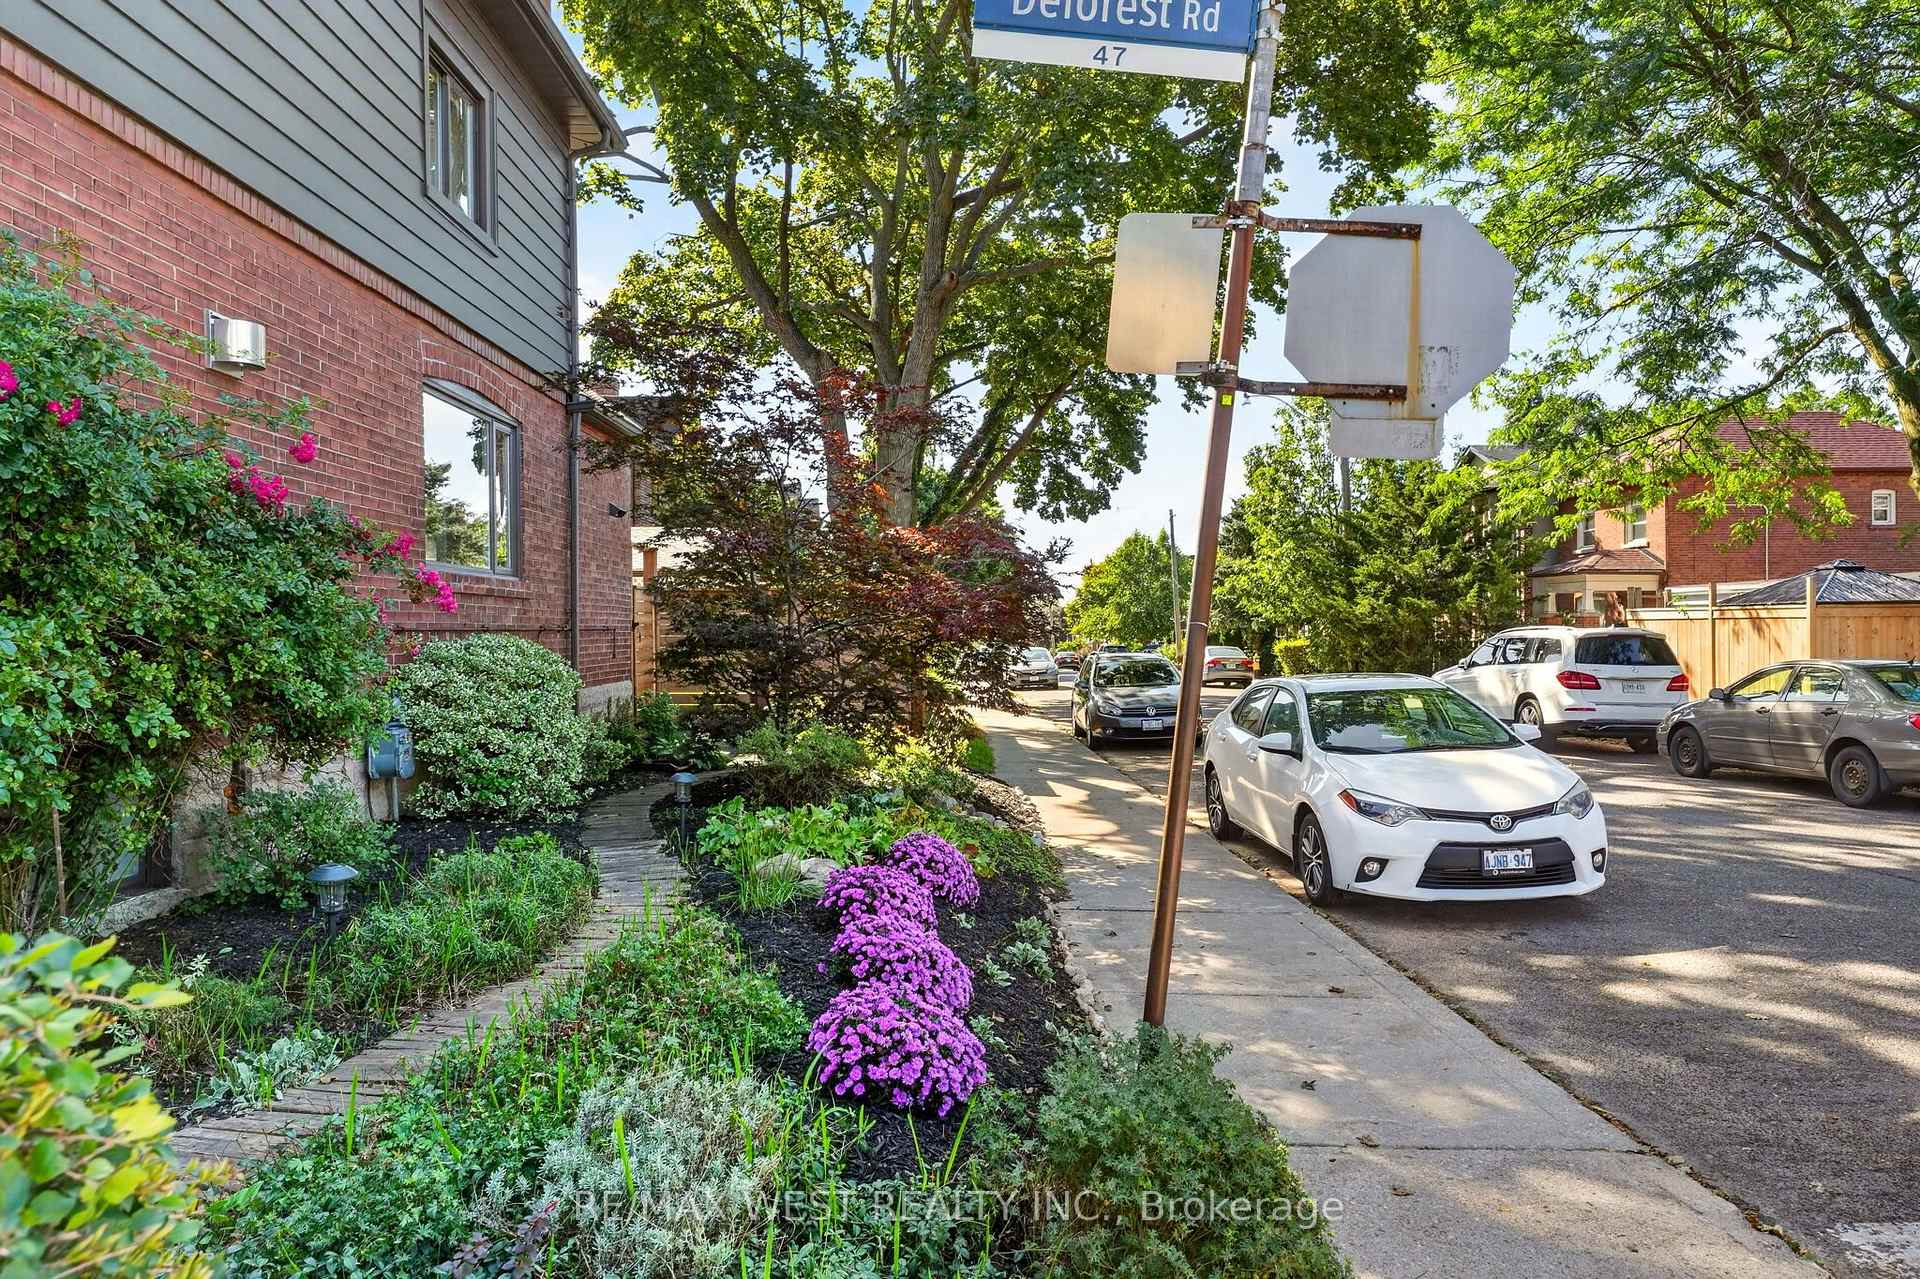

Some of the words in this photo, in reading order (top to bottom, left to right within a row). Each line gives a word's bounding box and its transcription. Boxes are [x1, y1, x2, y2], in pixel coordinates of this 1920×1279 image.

[1183, 0, 1220, 32] Rd
[1092, 46, 1127, 66] 47
[1513, 853, 1532, 867] 947
